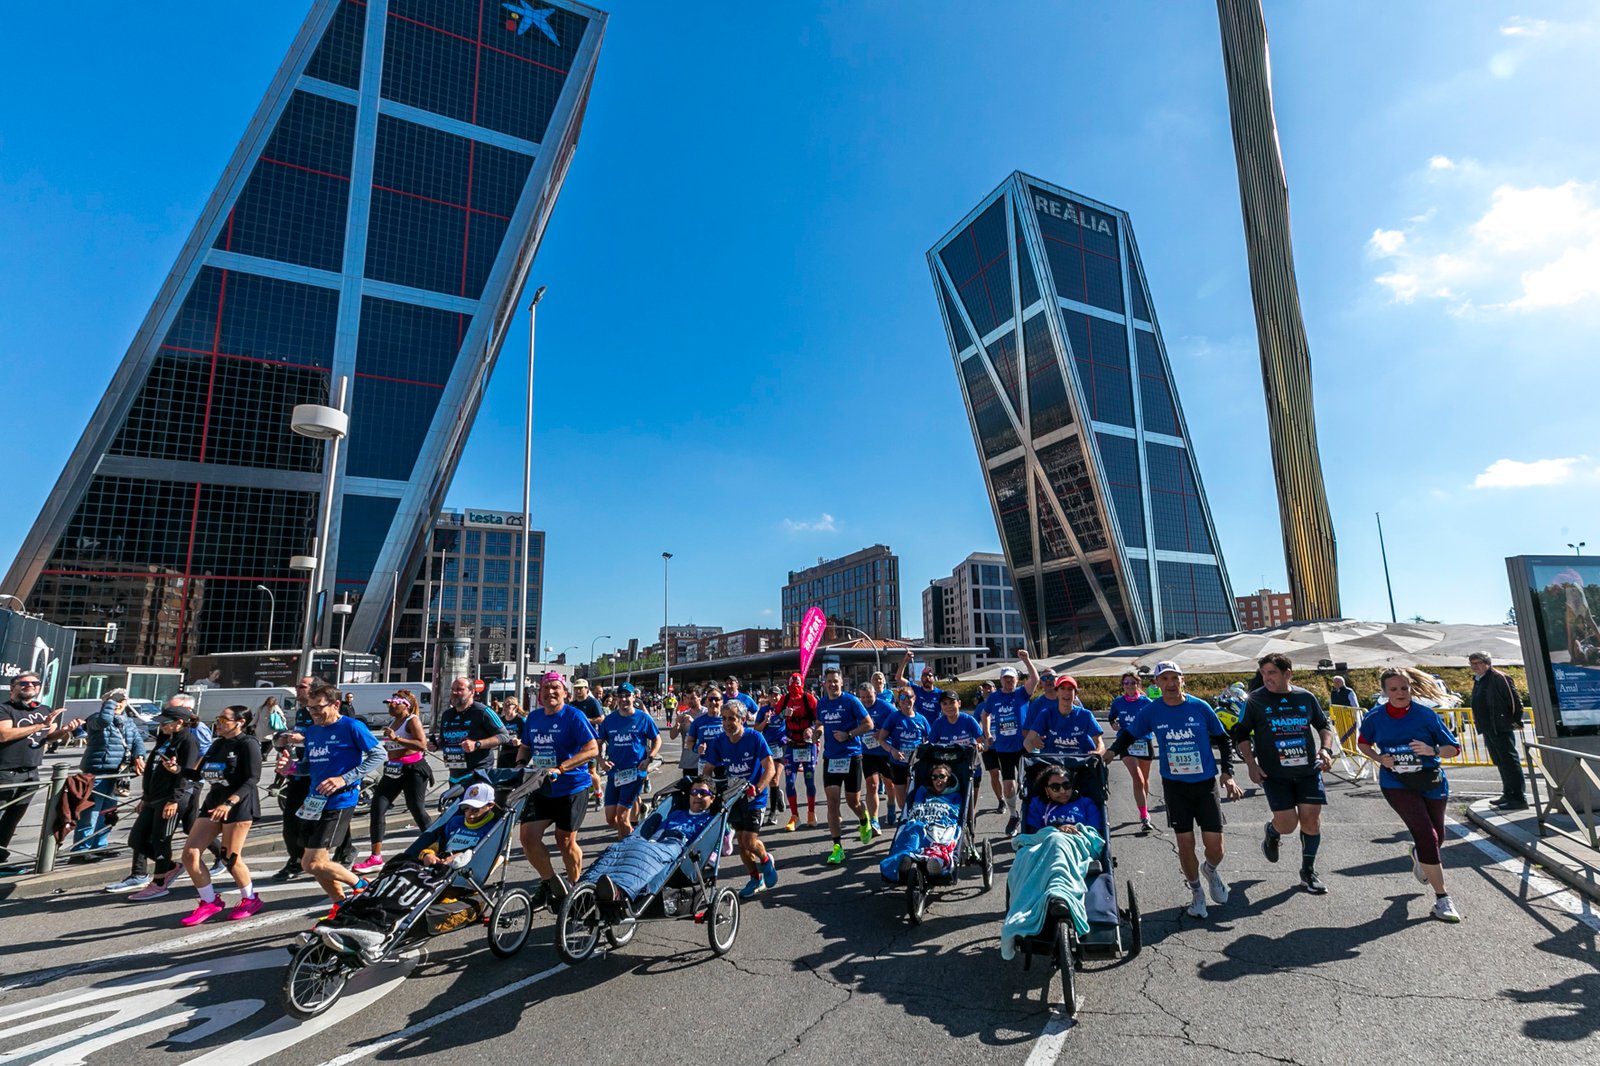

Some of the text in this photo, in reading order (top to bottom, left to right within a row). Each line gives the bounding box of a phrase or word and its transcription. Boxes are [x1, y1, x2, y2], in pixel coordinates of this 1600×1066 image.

[469, 512, 503, 525] testa
[1271, 717, 1308, 726] MADRID
[1284, 747, 1304, 756] 39016
[1175, 755, 1192, 763] 8135
